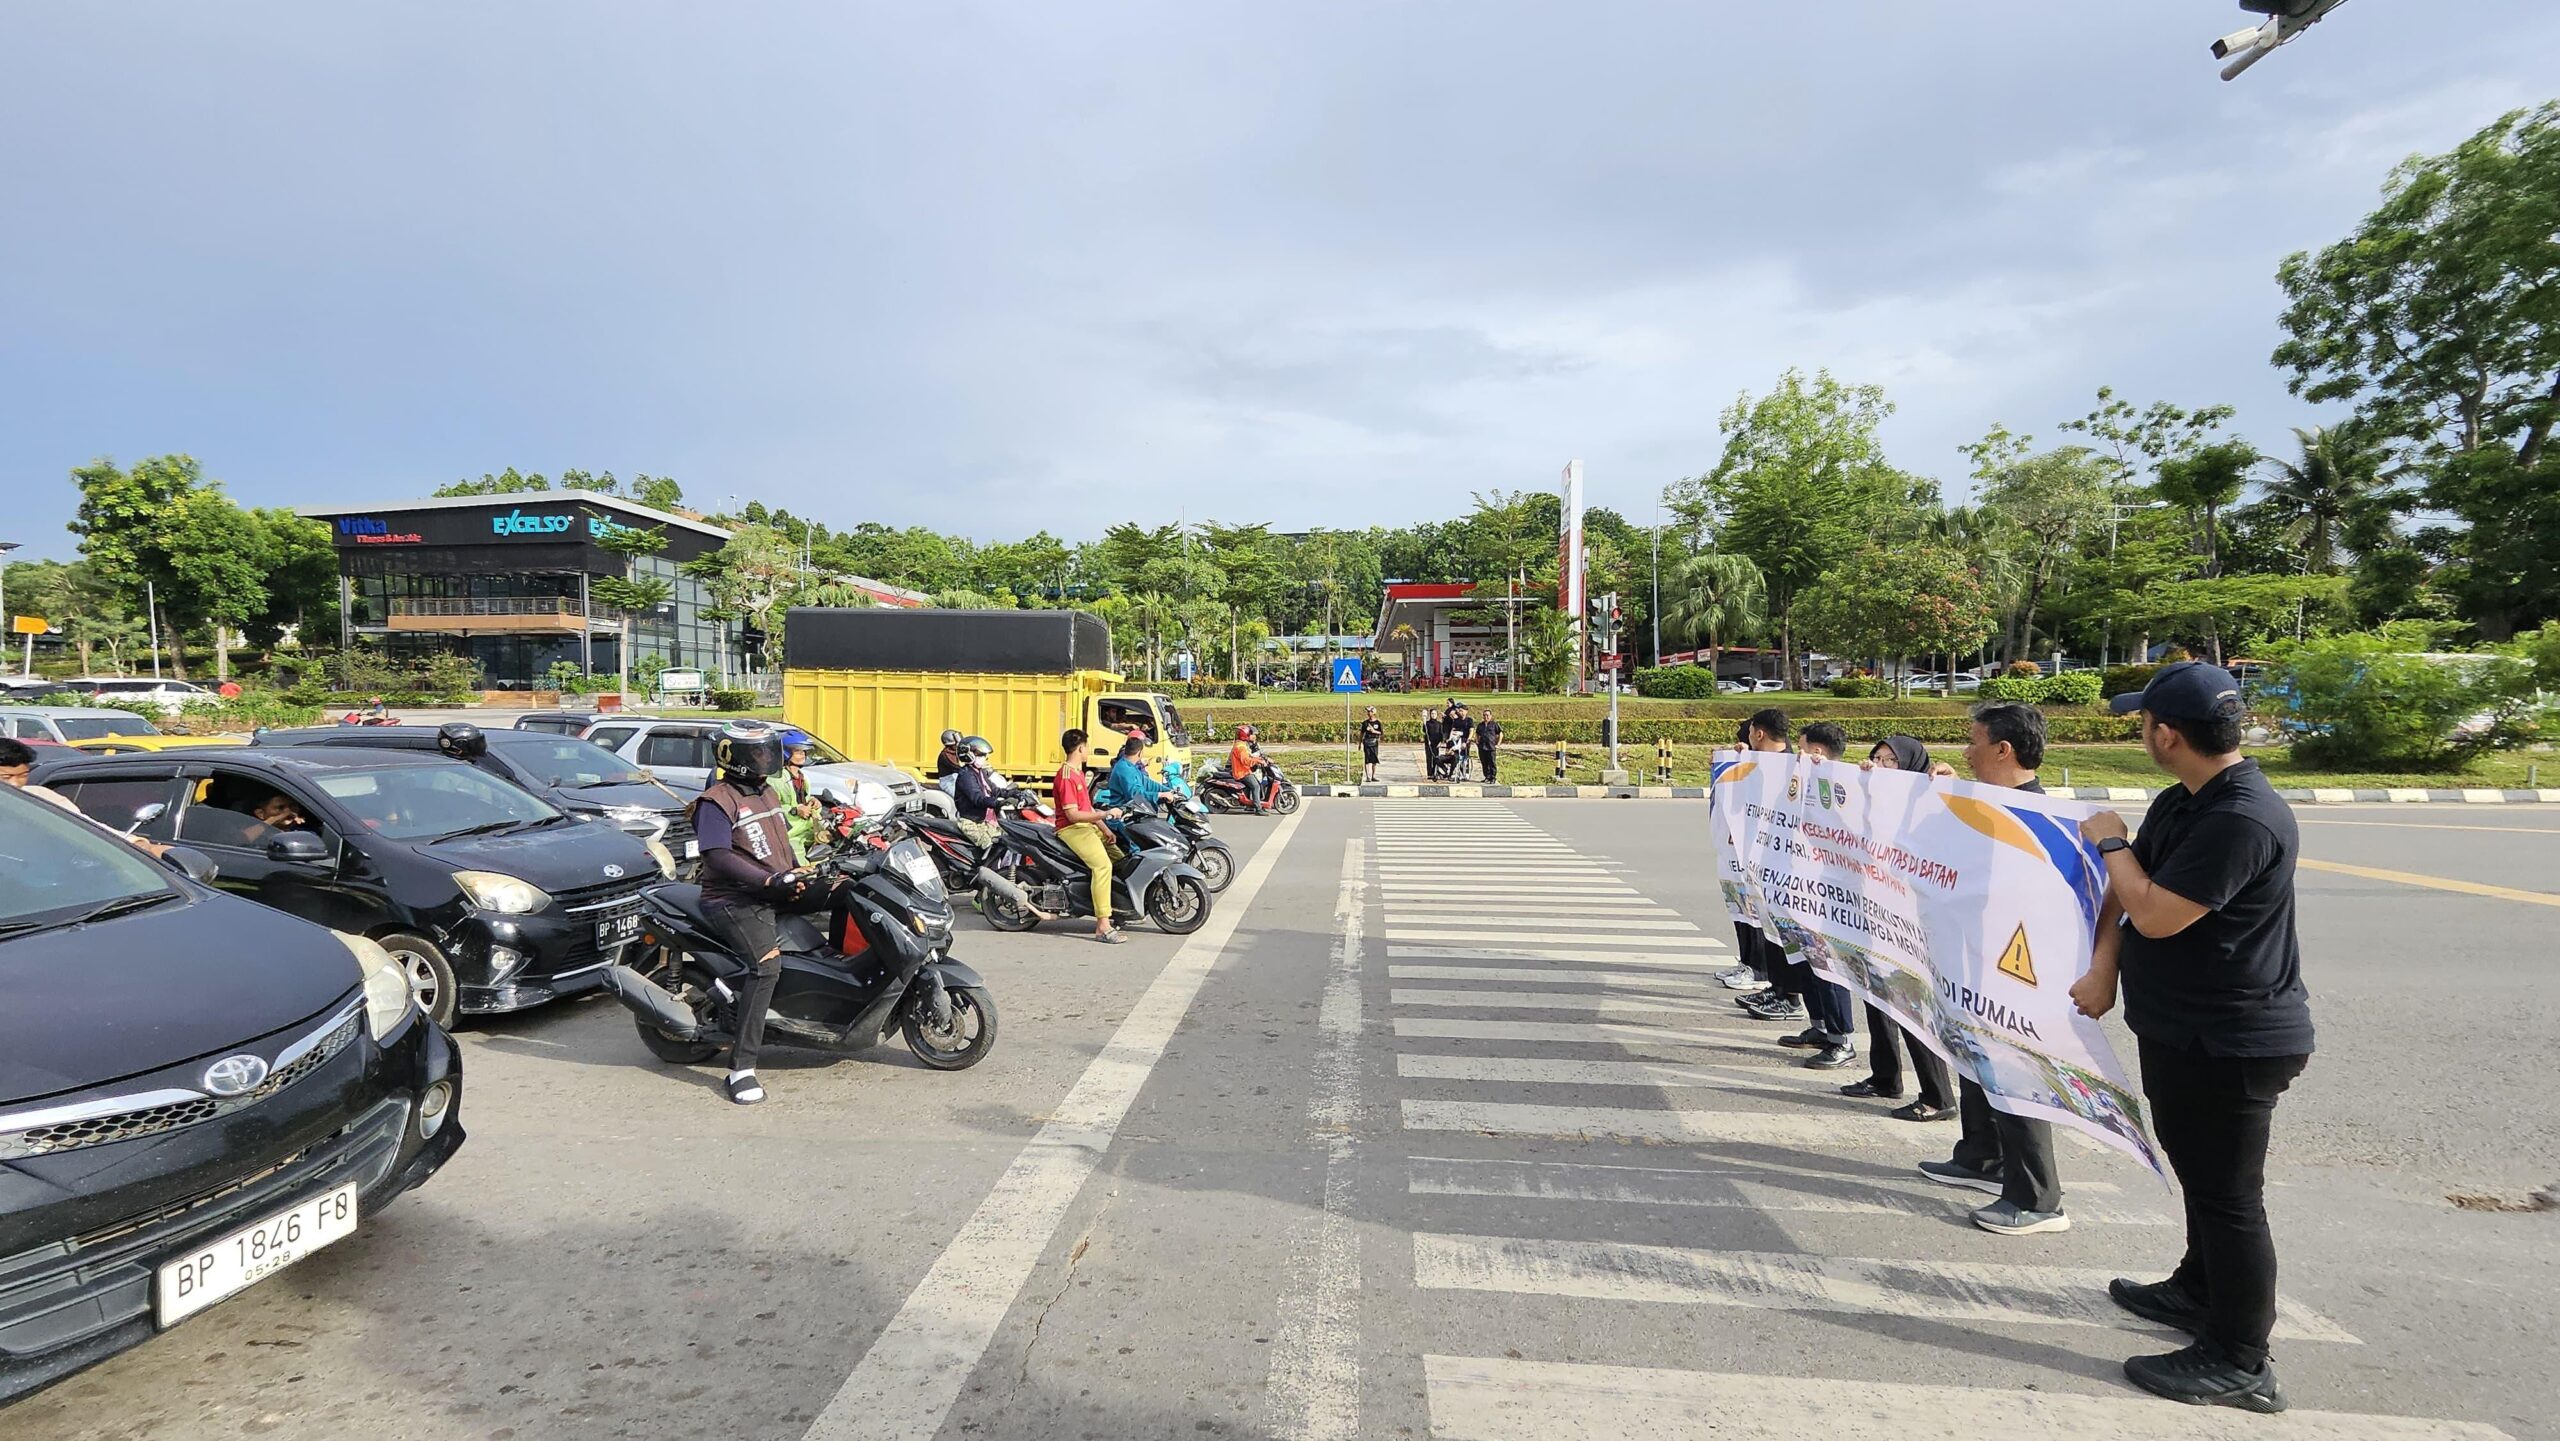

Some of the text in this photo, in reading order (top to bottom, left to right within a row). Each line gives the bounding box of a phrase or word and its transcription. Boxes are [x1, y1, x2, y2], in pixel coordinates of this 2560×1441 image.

[493, 510, 570, 536] EXCELSO
[1773, 836, 1781, 851] 3
[1812, 847, 1835, 866] SATU
[1877, 843, 1909, 871] LINTAS
[1908, 855, 1919, 875] DI
[1919, 858, 1958, 890] BATAM
[1806, 879, 1861, 911] KORBAN
[599, 922, 610, 938] BP
[1773, 889, 1827, 919] KARENA
[1831, 905, 1895, 946] KELUARGA
[1942, 975, 1956, 1003] DI
[1961, 986, 2042, 1042] RUMAH
[178, 1253, 215, 1298] BP
[237, 1213, 301, 1267] 1846
